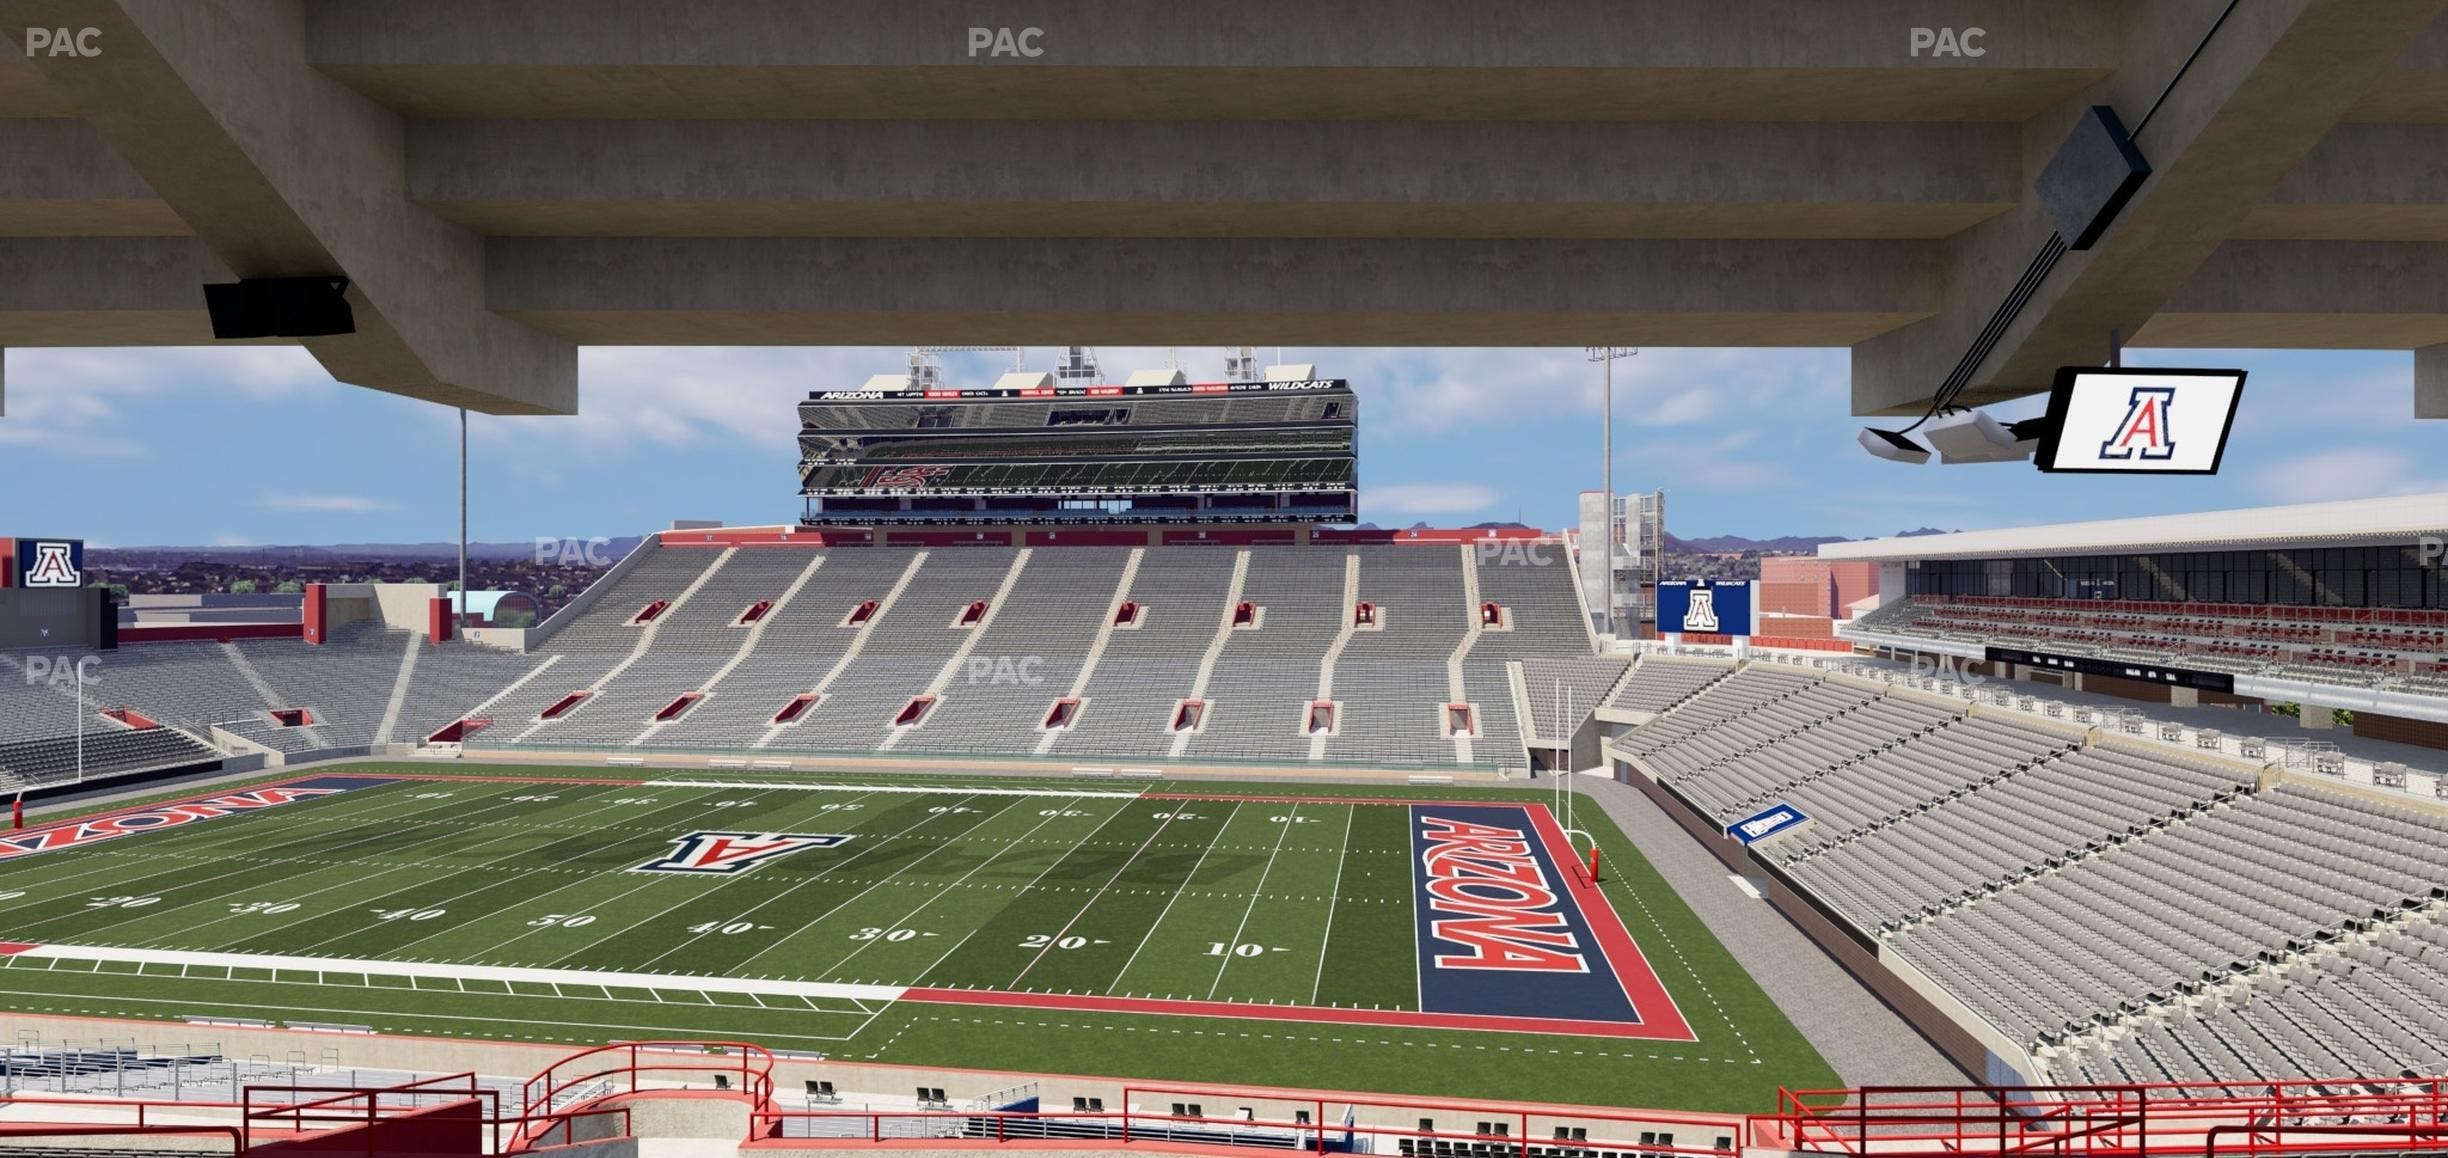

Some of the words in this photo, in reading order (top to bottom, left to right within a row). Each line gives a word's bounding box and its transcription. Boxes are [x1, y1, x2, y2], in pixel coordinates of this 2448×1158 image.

[1268, 380, 1334, 390] WILDCATS
[820, 391, 884, 400] ARIZONA
[2099, 387, 2175, 460] A
[25, 542, 81, 587] A
[1683, 589, 1719, 631] A
[624, 829, 857, 876] A
[86, 896, 162, 908] 20
[1421, 815, 1591, 974] ARIZONA
[230, 902, 301, 914] 30
[376, 908, 446, 921] 40
[526, 914, 597, 928] 50
[686, 921, 753, 935] 40
[848, 927, 917, 942] 30
[1018, 934, 1087, 950] 20
[1202, 942, 1263, 958] 10
